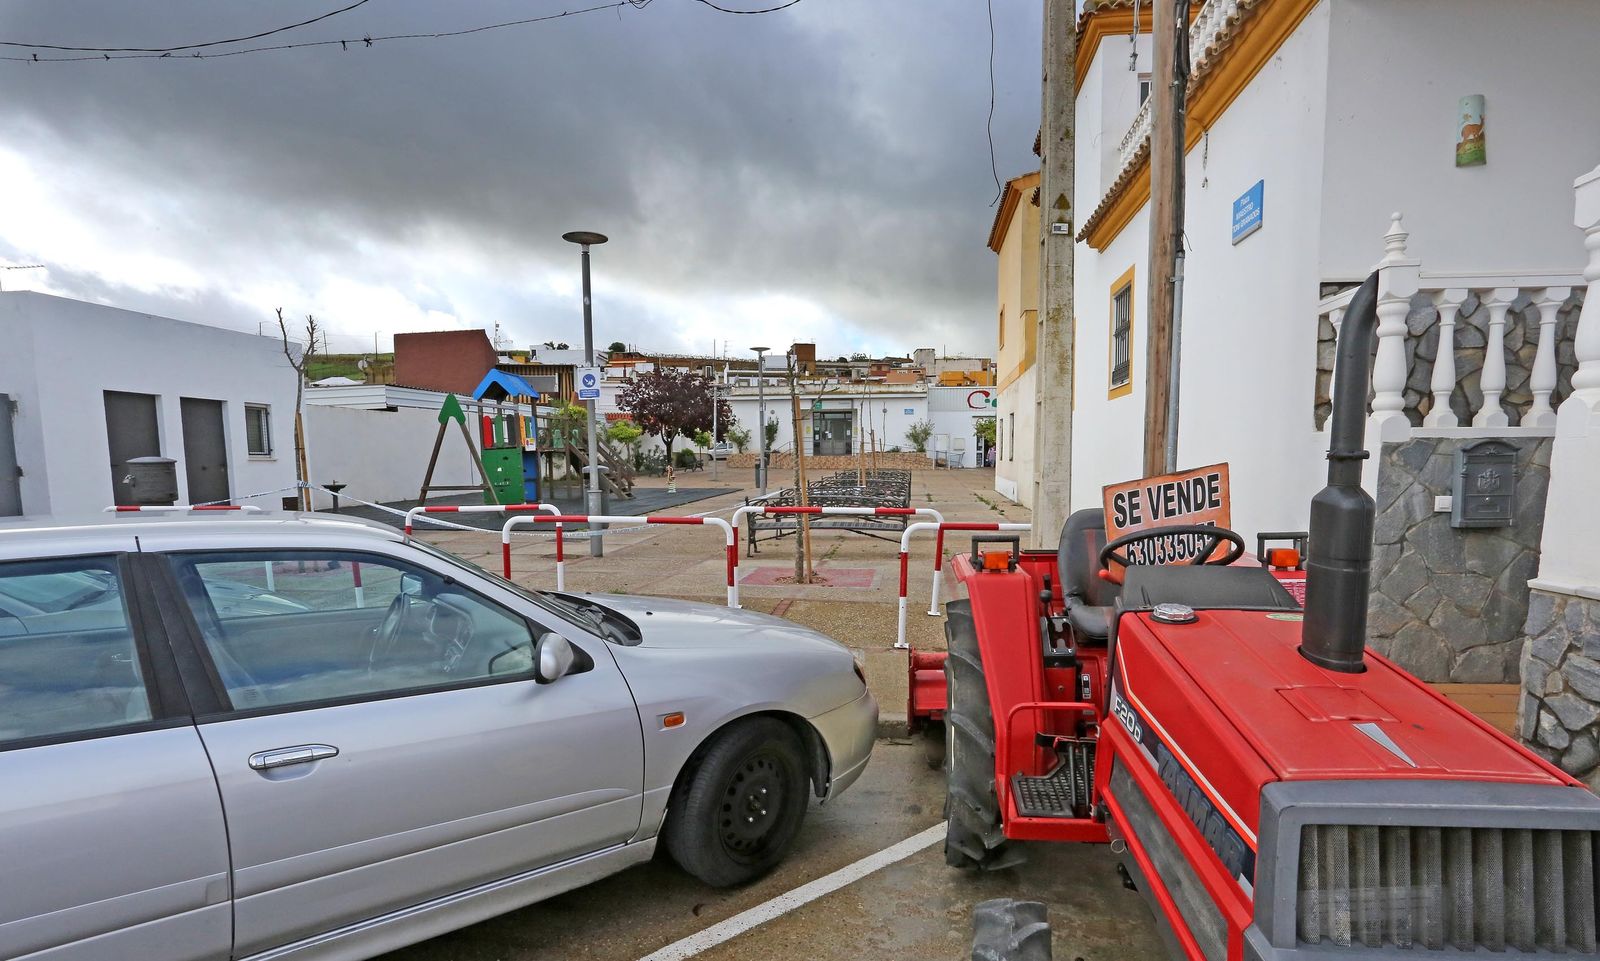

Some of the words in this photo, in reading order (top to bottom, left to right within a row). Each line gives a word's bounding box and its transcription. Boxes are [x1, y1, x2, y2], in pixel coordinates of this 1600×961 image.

[1113, 489, 1142, 529] SE
[1146, 473, 1221, 520] VENDE
[1114, 696, 1142, 743] F20D
[1157, 743, 1245, 881] YANMAR
